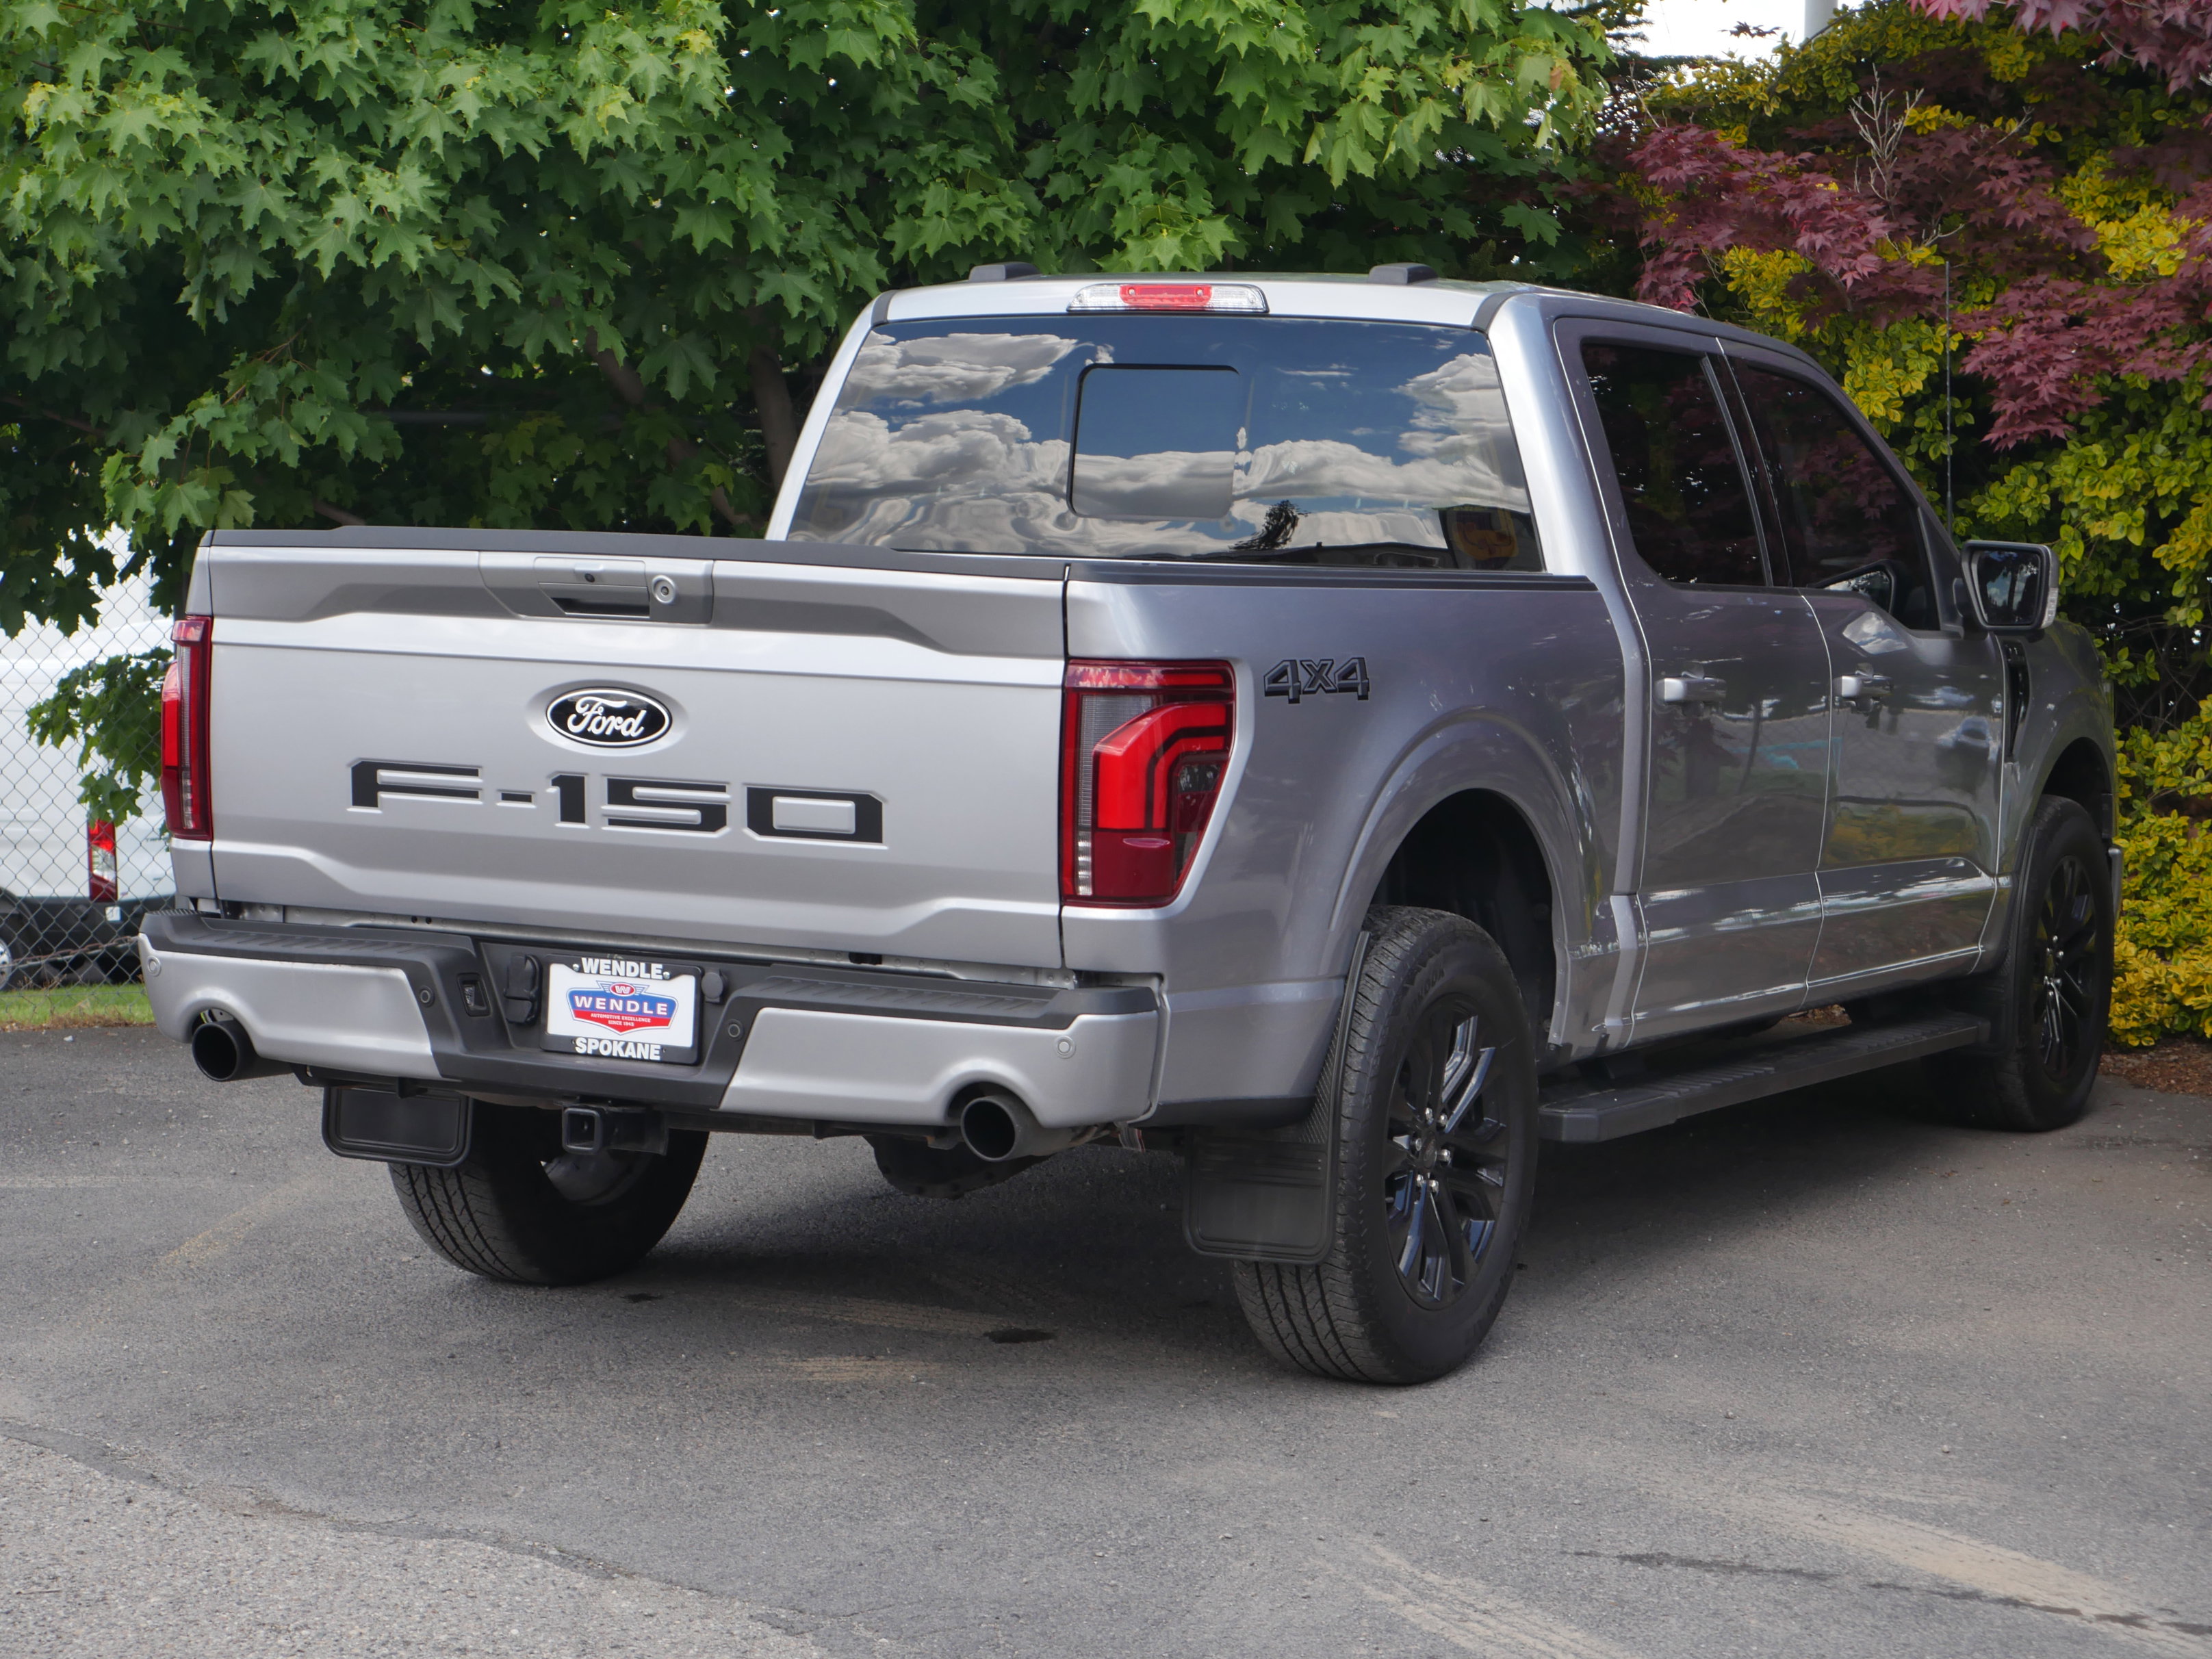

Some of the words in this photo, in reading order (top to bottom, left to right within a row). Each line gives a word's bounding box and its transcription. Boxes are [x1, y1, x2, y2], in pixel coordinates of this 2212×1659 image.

[567, 695, 645, 738] Ford
[347, 758, 888, 849] F-150
[582, 957, 663, 980] WENDLE
[574, 995, 668, 1016] WENDLE
[575, 1037, 660, 1061] SPOKANE
